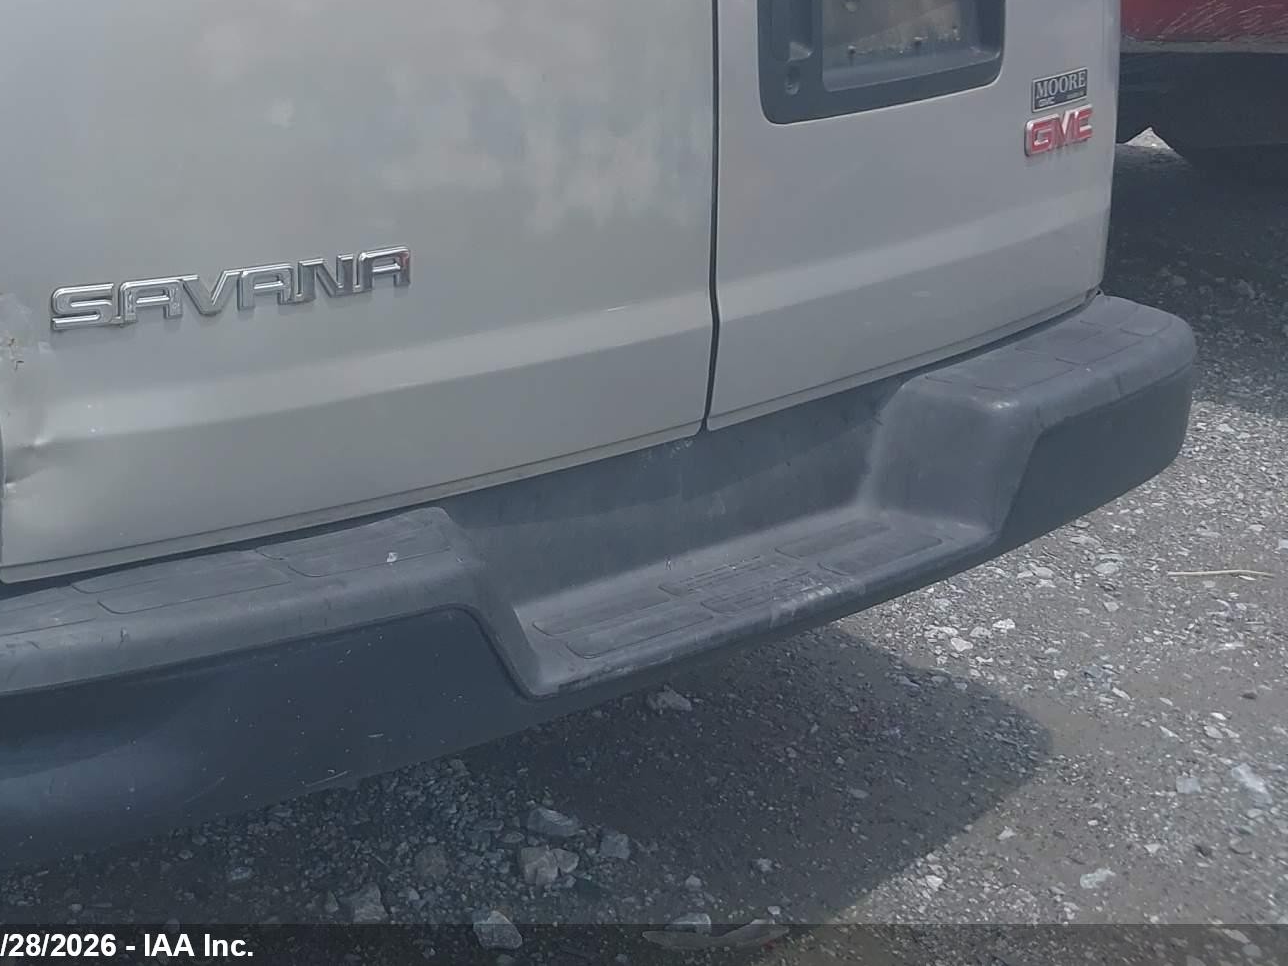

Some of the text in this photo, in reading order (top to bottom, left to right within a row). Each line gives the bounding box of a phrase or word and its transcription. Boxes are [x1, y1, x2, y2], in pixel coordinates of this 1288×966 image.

[1036, 71, 1086, 98] MOORE
[1024, 104, 1093, 156] GMC
[51, 246, 411, 330] SAVANA
